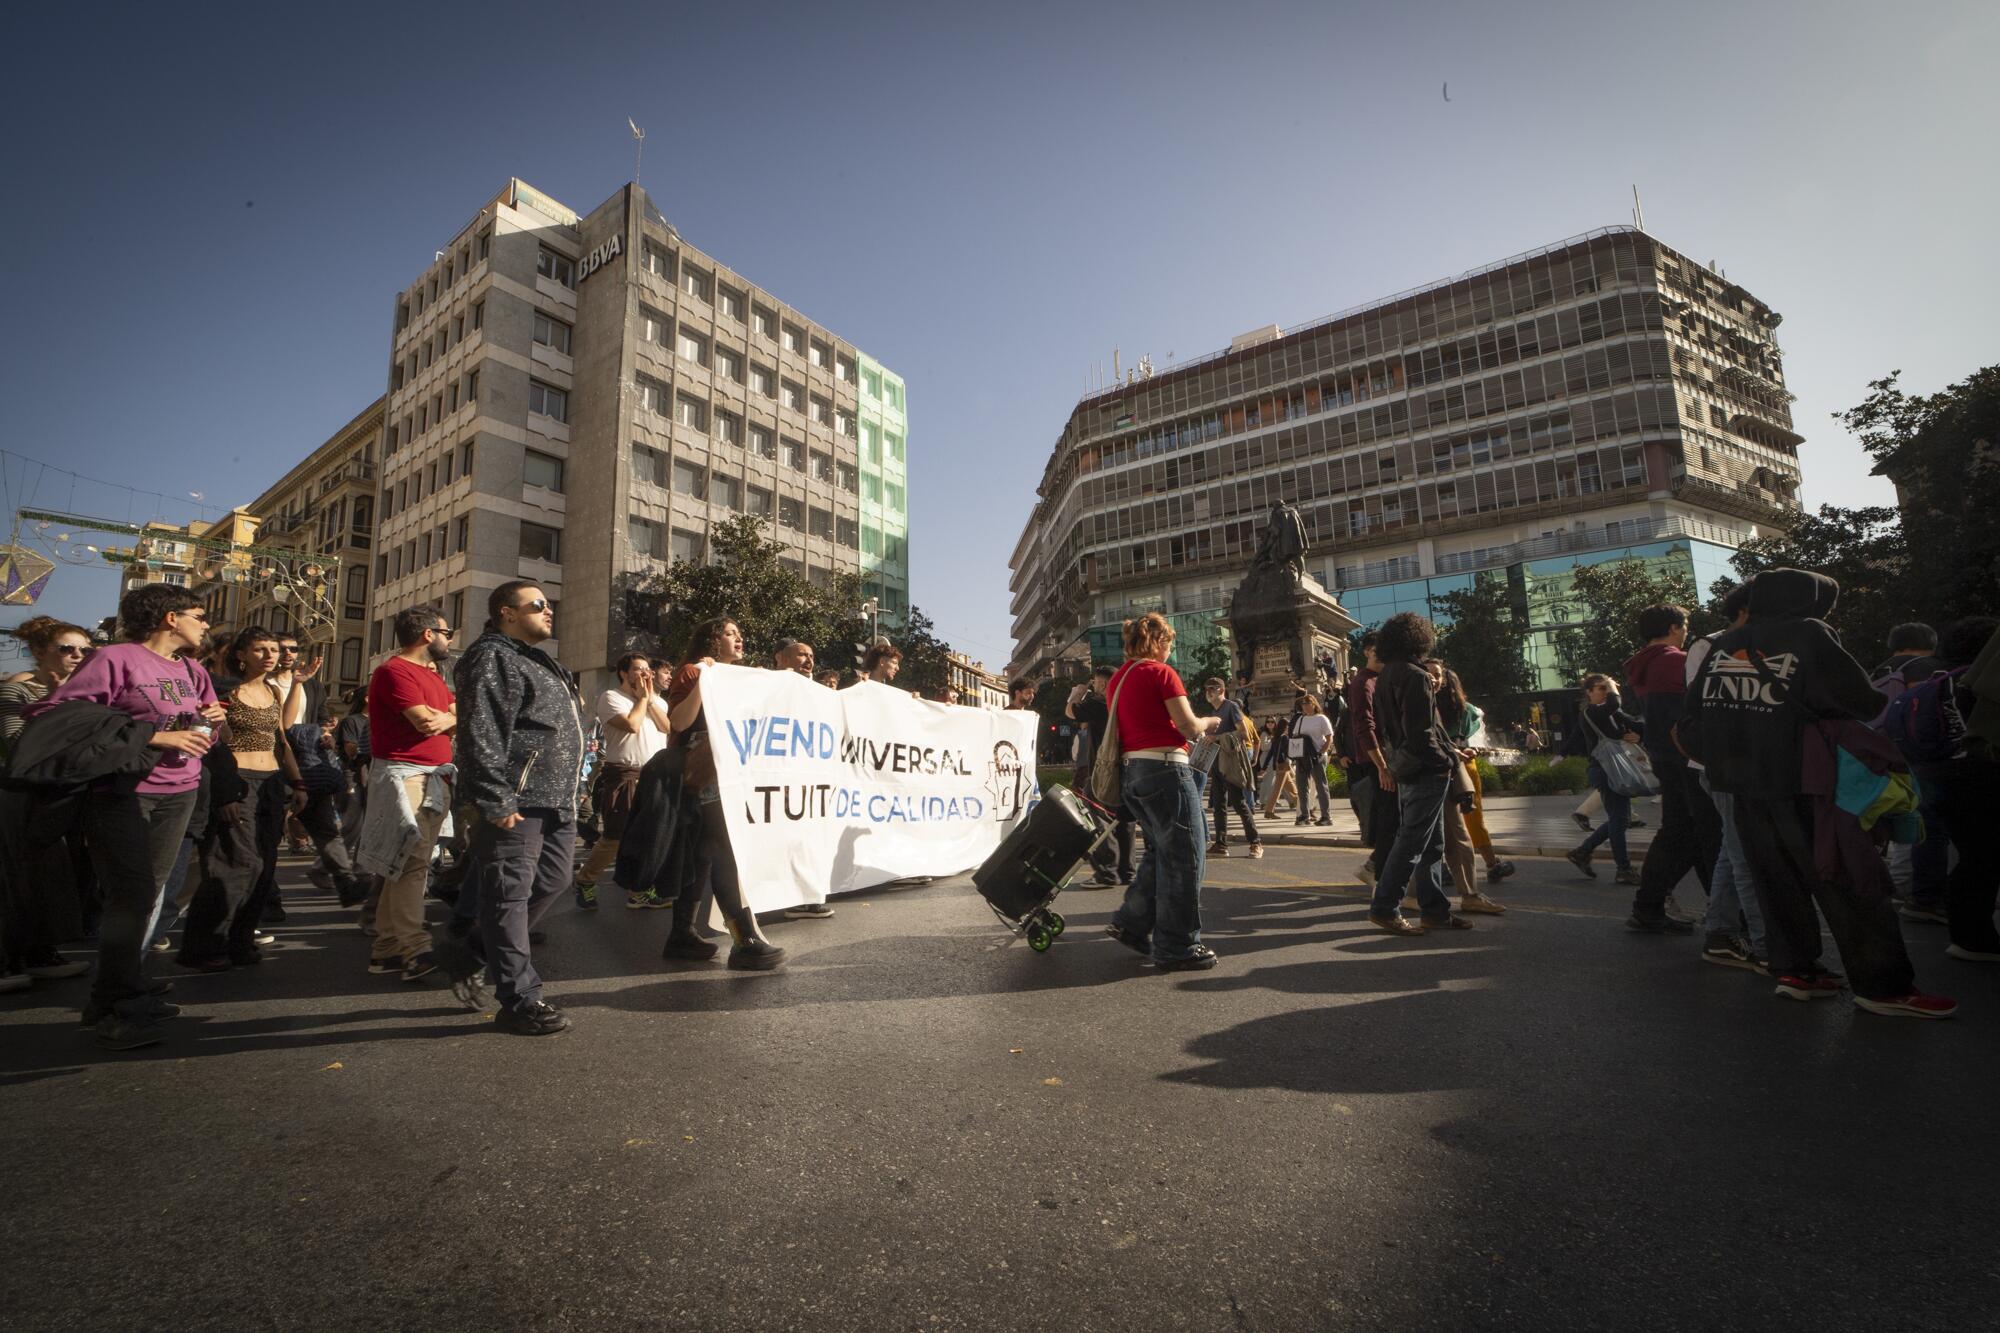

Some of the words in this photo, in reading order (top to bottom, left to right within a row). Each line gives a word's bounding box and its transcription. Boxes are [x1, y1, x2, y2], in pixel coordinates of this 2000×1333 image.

[578, 233, 621, 282] BBVA
[1702, 676, 1790, 705] LNDC
[835, 788, 862, 818] DE
[867, 794, 983, 823] CALIDAD
